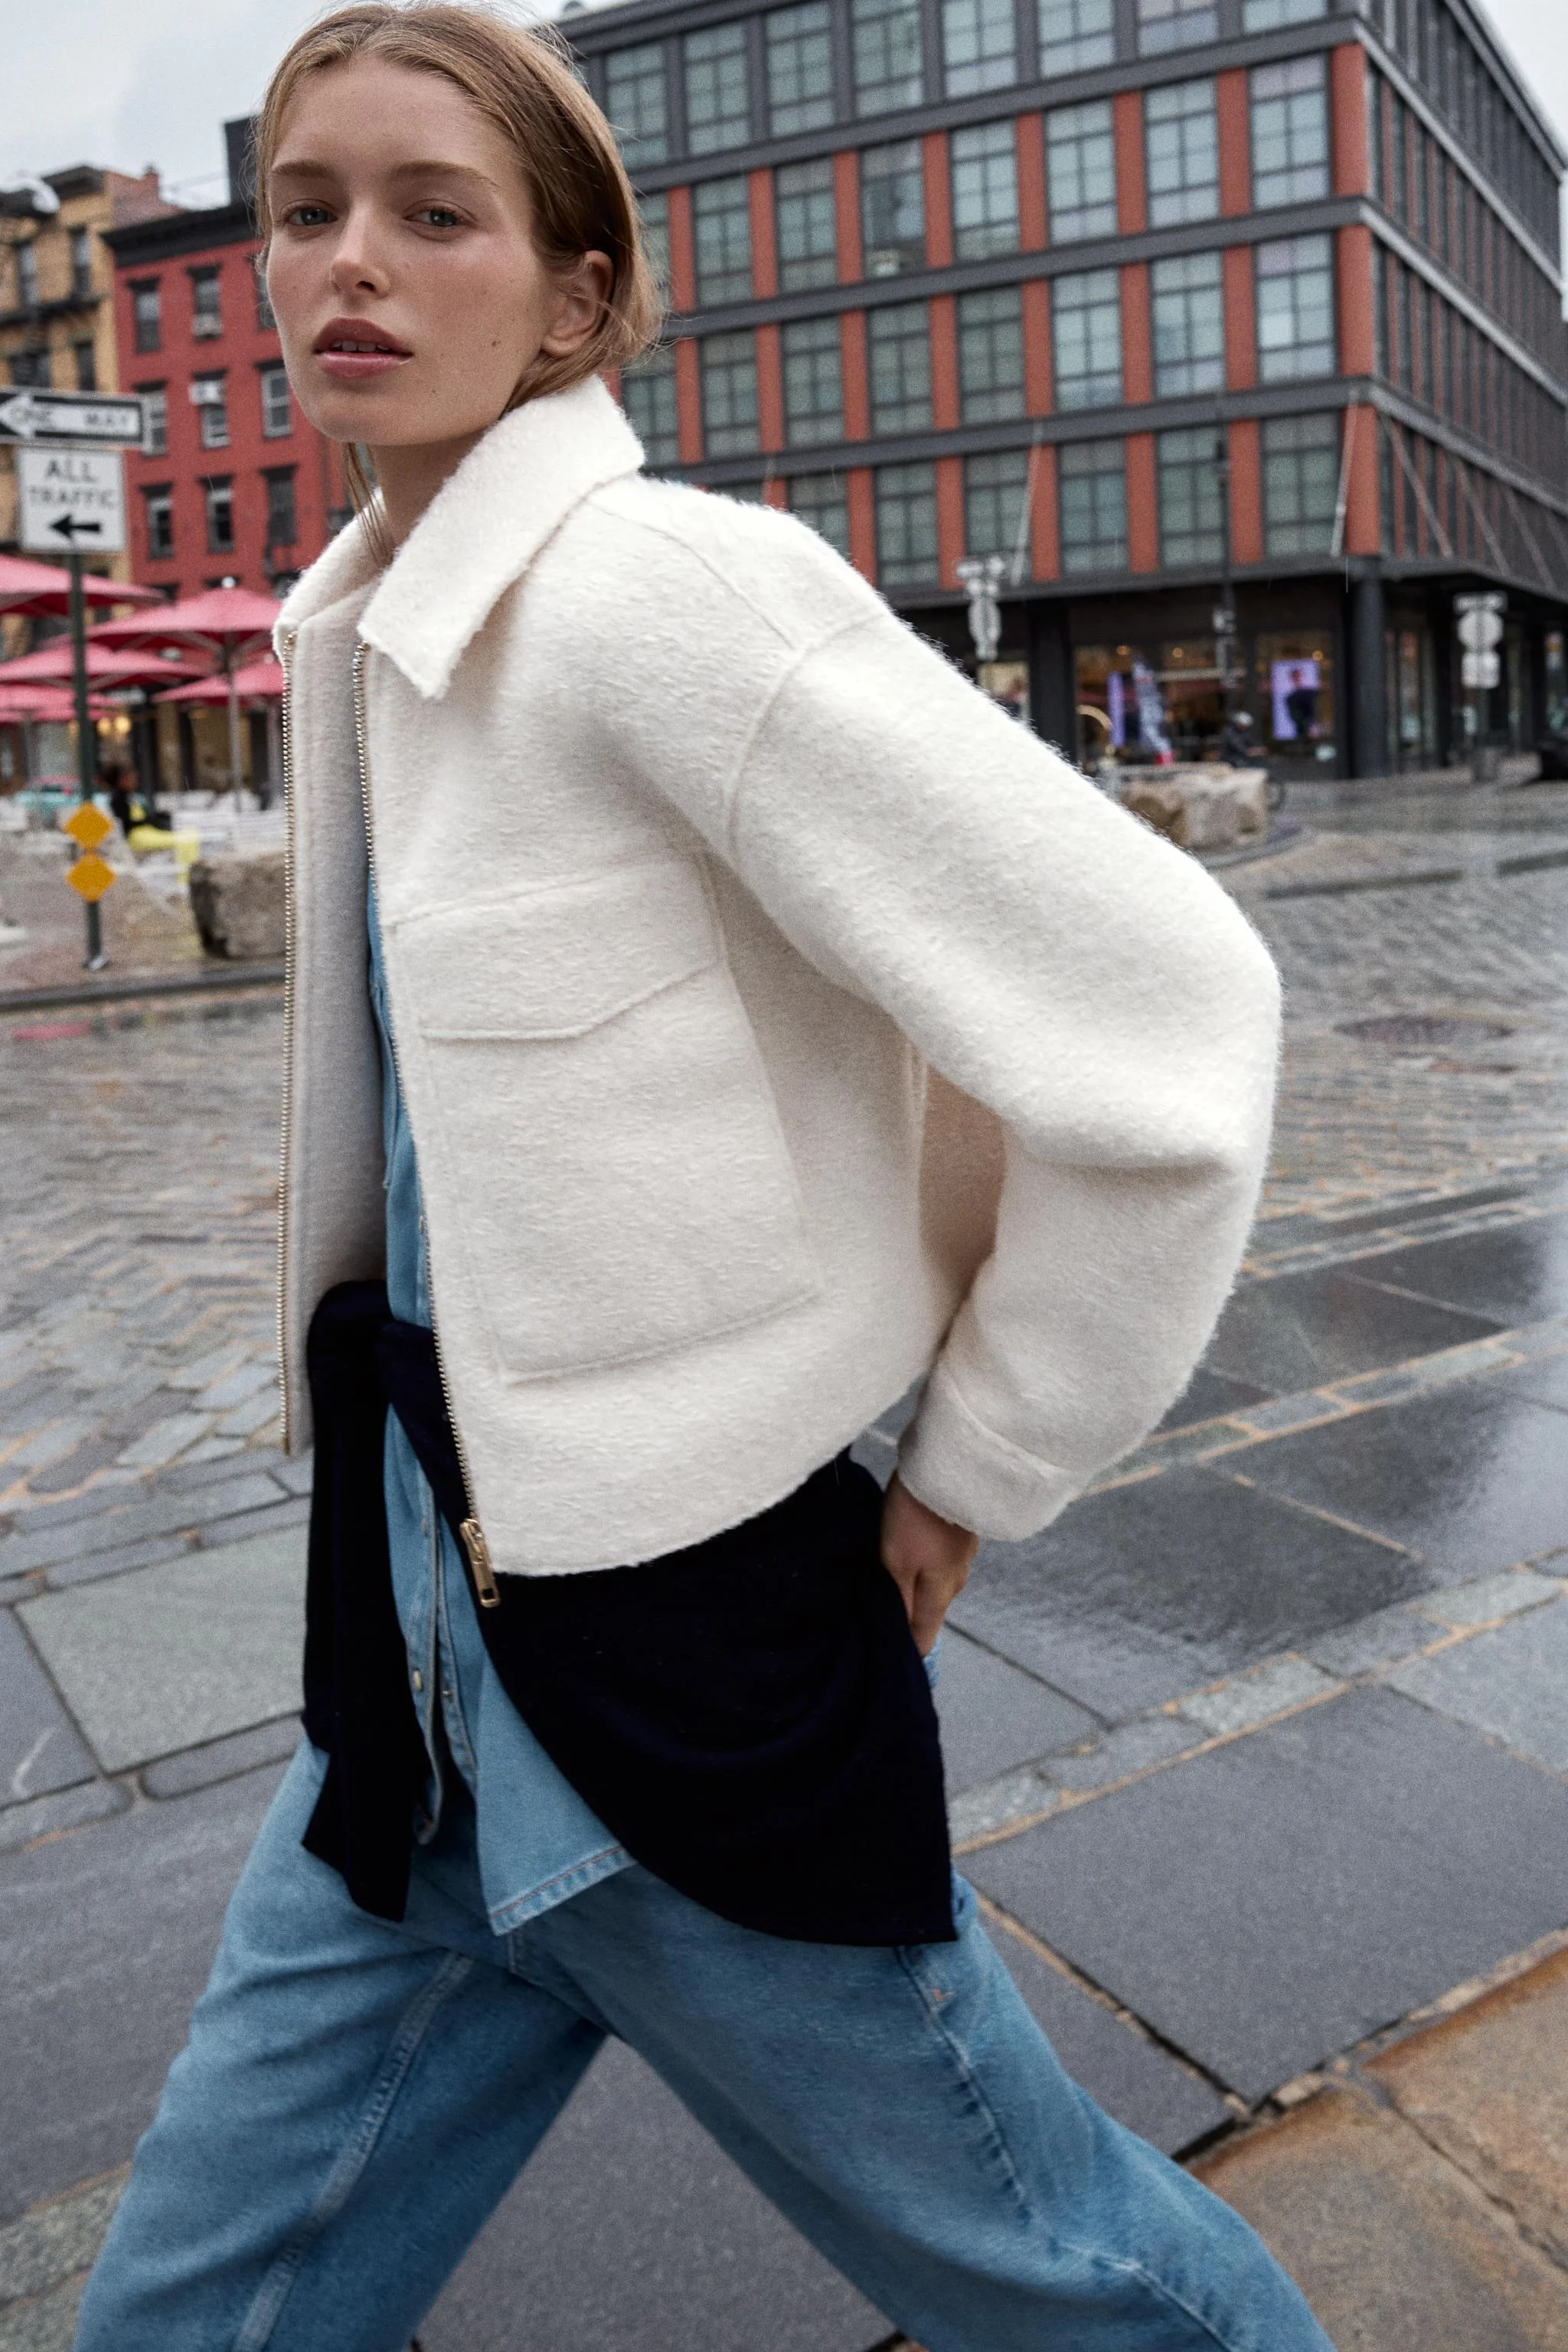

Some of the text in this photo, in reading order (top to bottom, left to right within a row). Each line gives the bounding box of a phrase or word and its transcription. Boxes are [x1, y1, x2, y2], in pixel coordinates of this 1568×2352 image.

[84, 410, 131, 430] WAY
[45, 459, 97, 482] ALL
[29, 486, 114, 509] TRAFFIC
